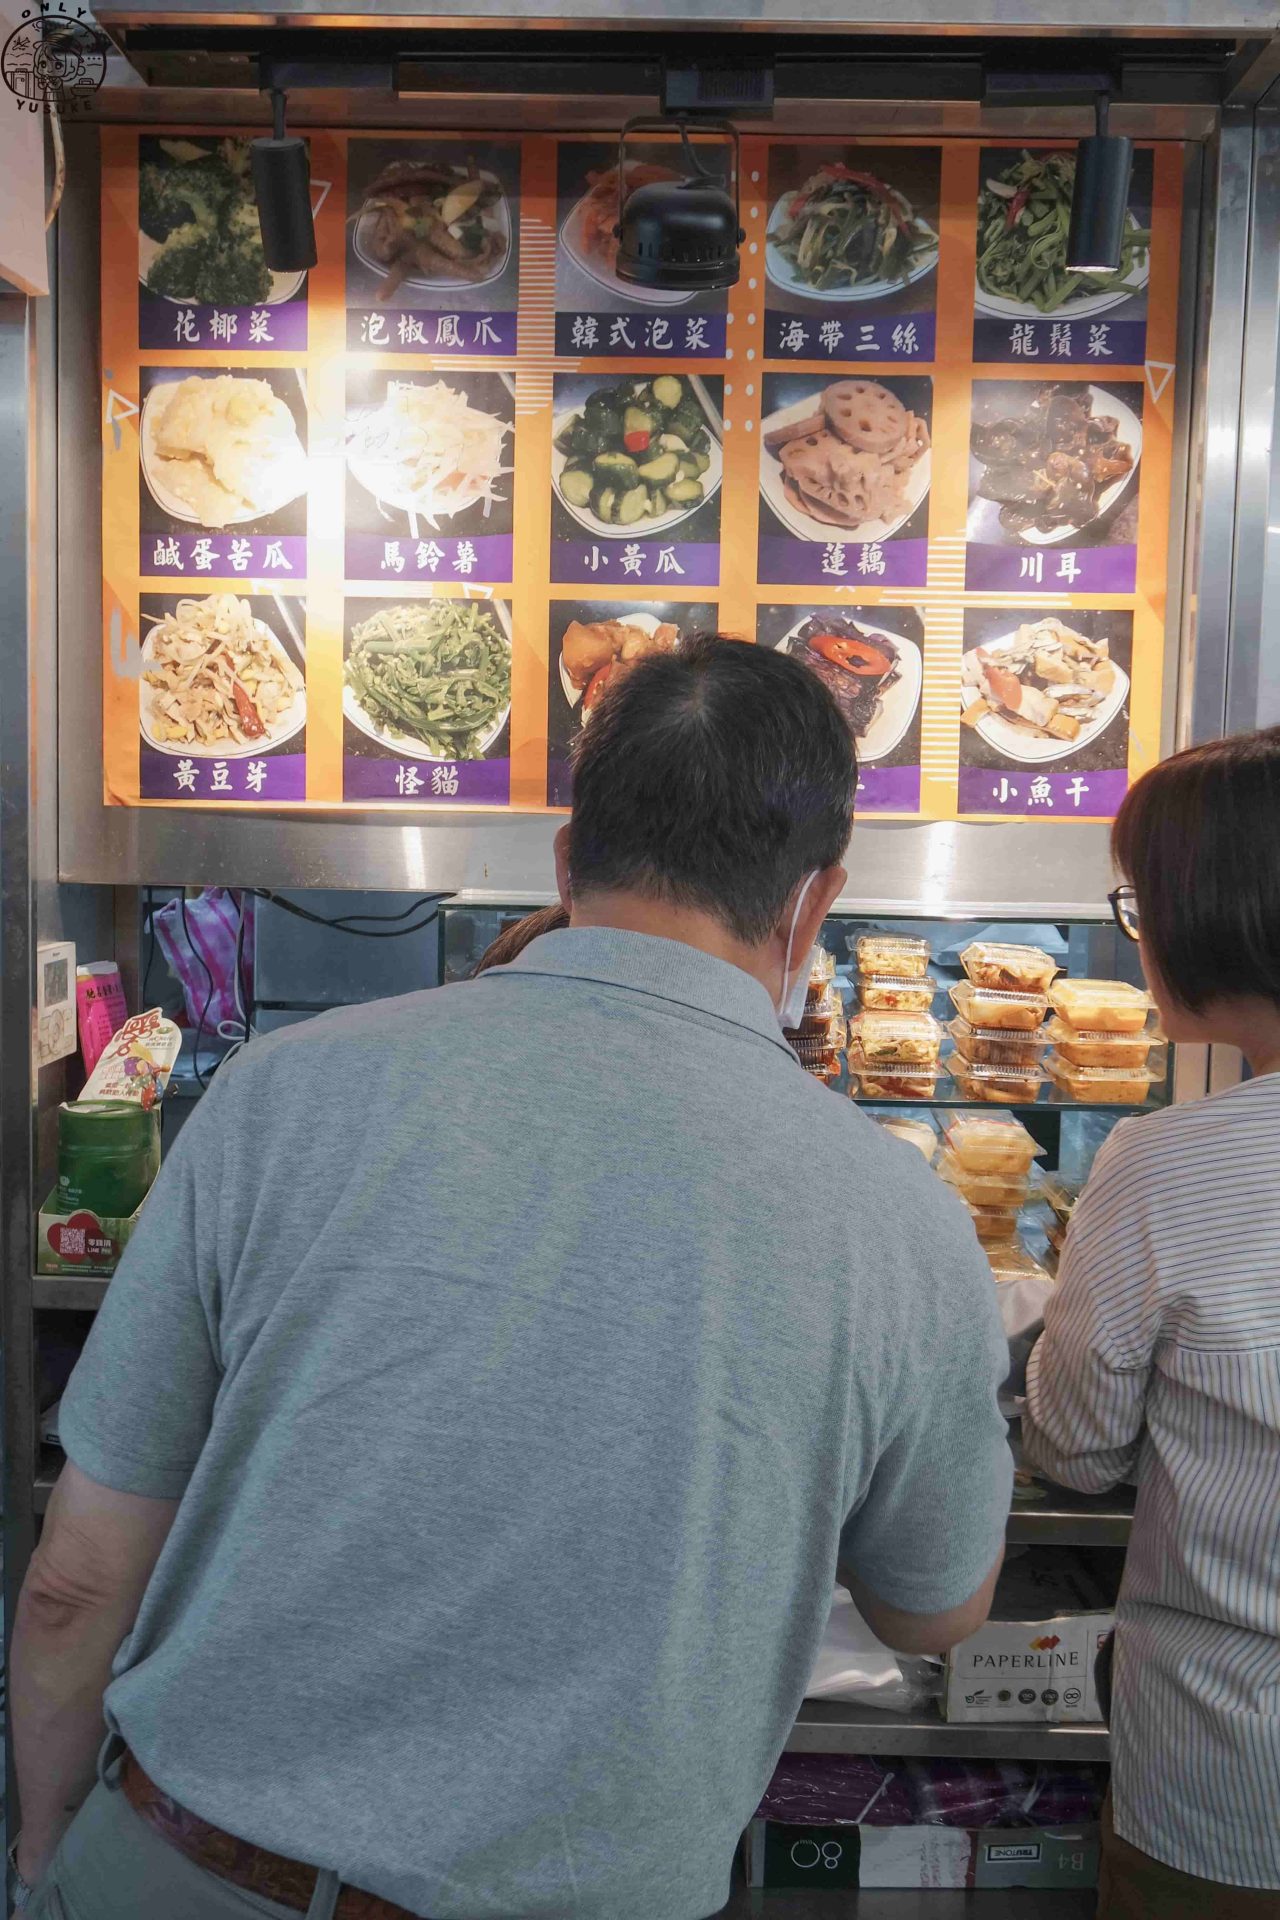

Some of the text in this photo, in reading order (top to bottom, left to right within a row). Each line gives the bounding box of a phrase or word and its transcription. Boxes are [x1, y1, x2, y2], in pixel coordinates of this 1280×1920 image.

[173, 310, 275, 343] 花椰菜
[360, 314, 502, 347] 泡椒鳳爪
[570, 316, 711, 350] 韓式泡菜
[779, 322, 920, 354] 海帶三絲
[153, 537, 294, 571] 鹹蛋苦瓜
[381, 540, 478, 574] 馬鈴薯
[821, 542, 887, 576] 蓮藕
[1019, 552, 1082, 584] 川耳
[395, 765, 459, 796] 怪貓
[992, 775, 1090, 807] 小魚干
[973, 1651, 1080, 1668] PAPERLINE
